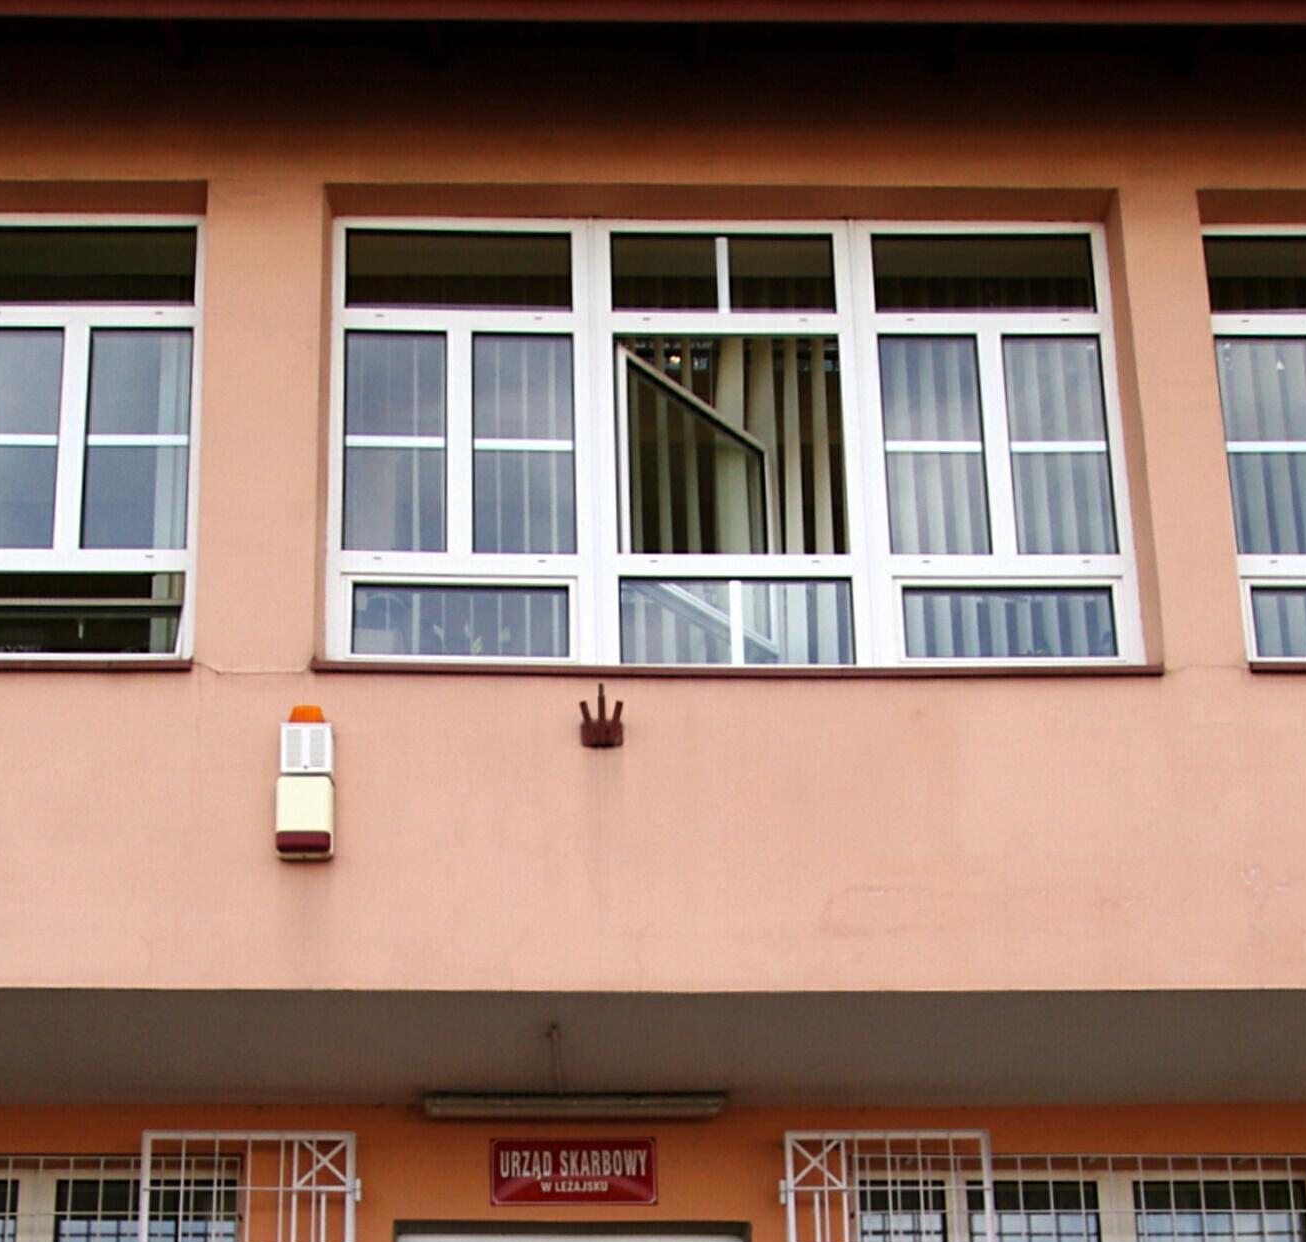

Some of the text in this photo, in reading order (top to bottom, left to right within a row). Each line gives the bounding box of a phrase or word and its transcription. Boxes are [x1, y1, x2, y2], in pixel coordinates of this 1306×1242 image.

[500, 1149, 648, 1181] URZĄD SKARBOWY
[541, 1181, 552, 1193] W
